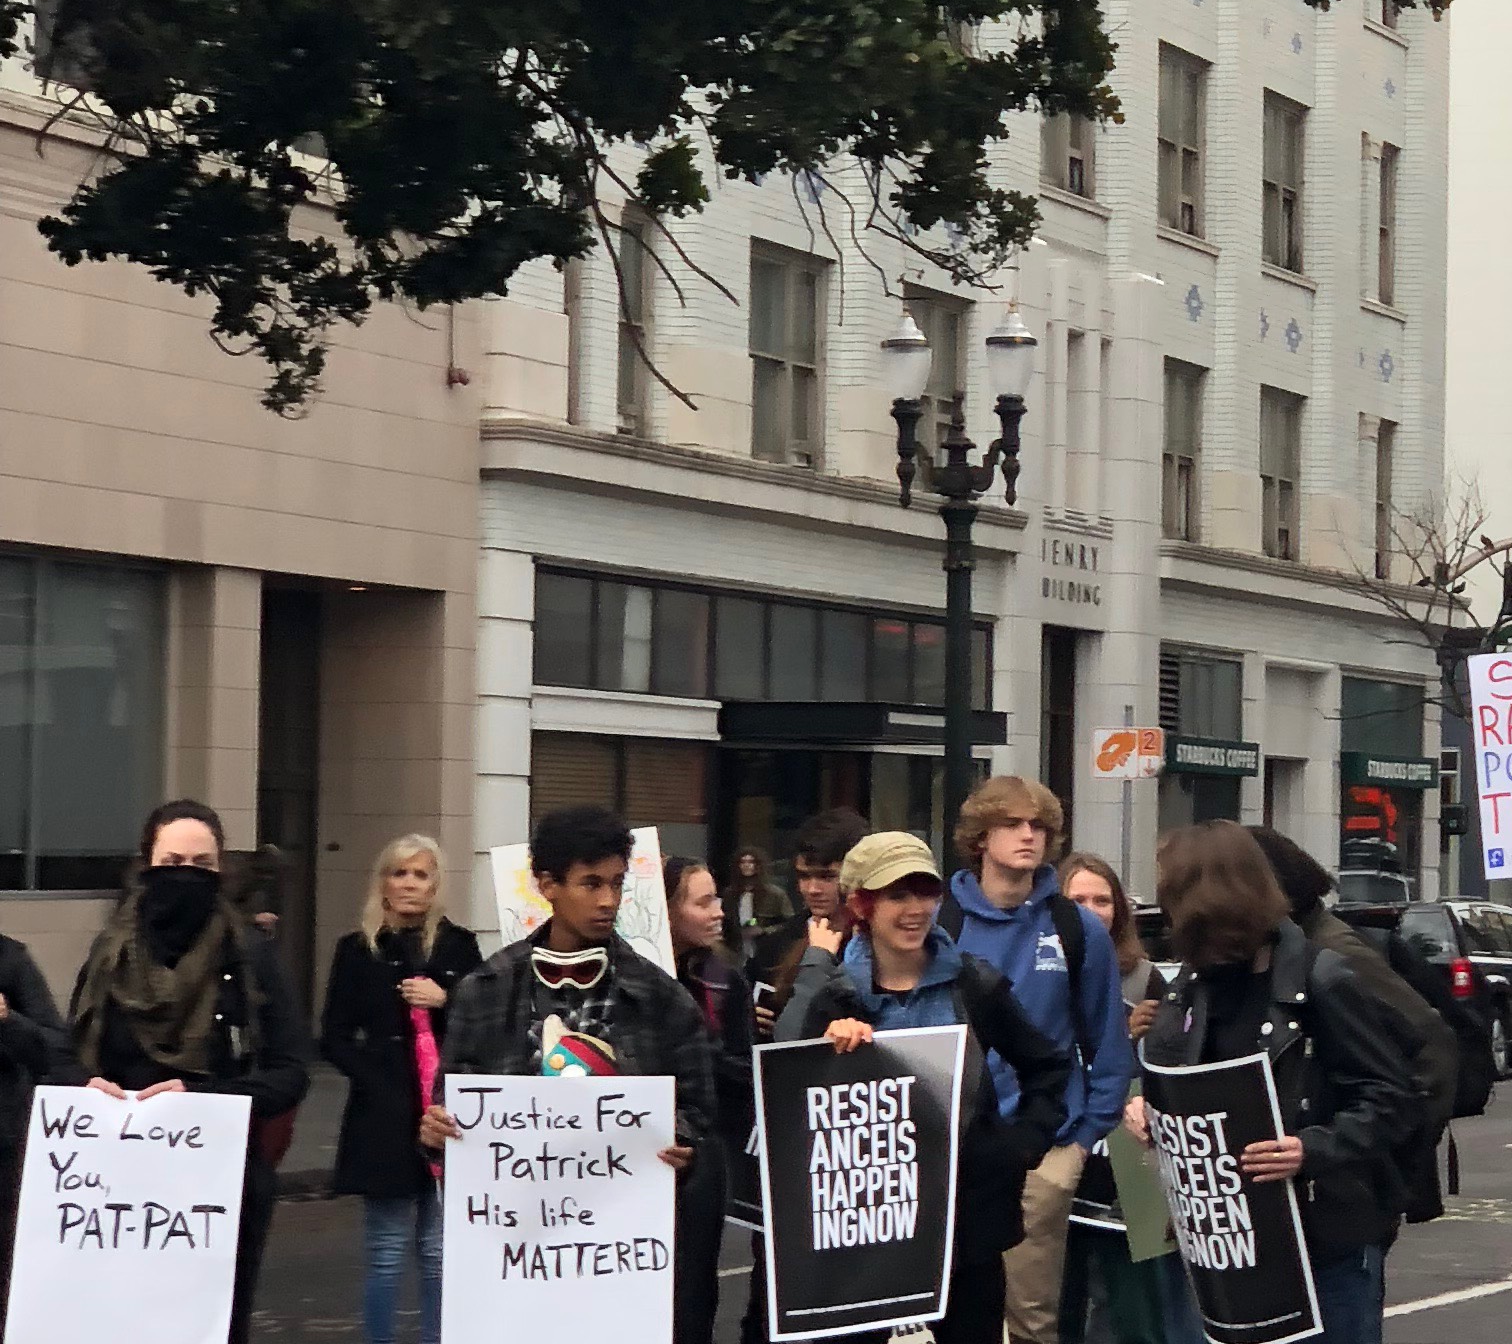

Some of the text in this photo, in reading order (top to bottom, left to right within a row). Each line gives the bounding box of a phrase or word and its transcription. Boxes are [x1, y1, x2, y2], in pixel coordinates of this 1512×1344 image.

[1144, 731, 1155, 750] 2
[40, 1097, 204, 1149] We Love
[453, 1087, 651, 1132] Justice For
[806, 1076, 916, 1131] RESIST
[809, 1119, 918, 1174] ANCEIS
[1146, 1106, 1228, 1157] ESIST
[489, 1141, 633, 1182] Patrick
[1160, 1151, 1242, 1197] CEIS
[467, 1193, 595, 1227] His life
[811, 1161, 919, 1213] HAPPEN
[57, 1201, 227, 1250] PAT-PAT
[812, 1200, 920, 1251] INGNOW
[1167, 1189, 1253, 1234] PPEN
[502, 1237, 669, 1281] MATTERED
